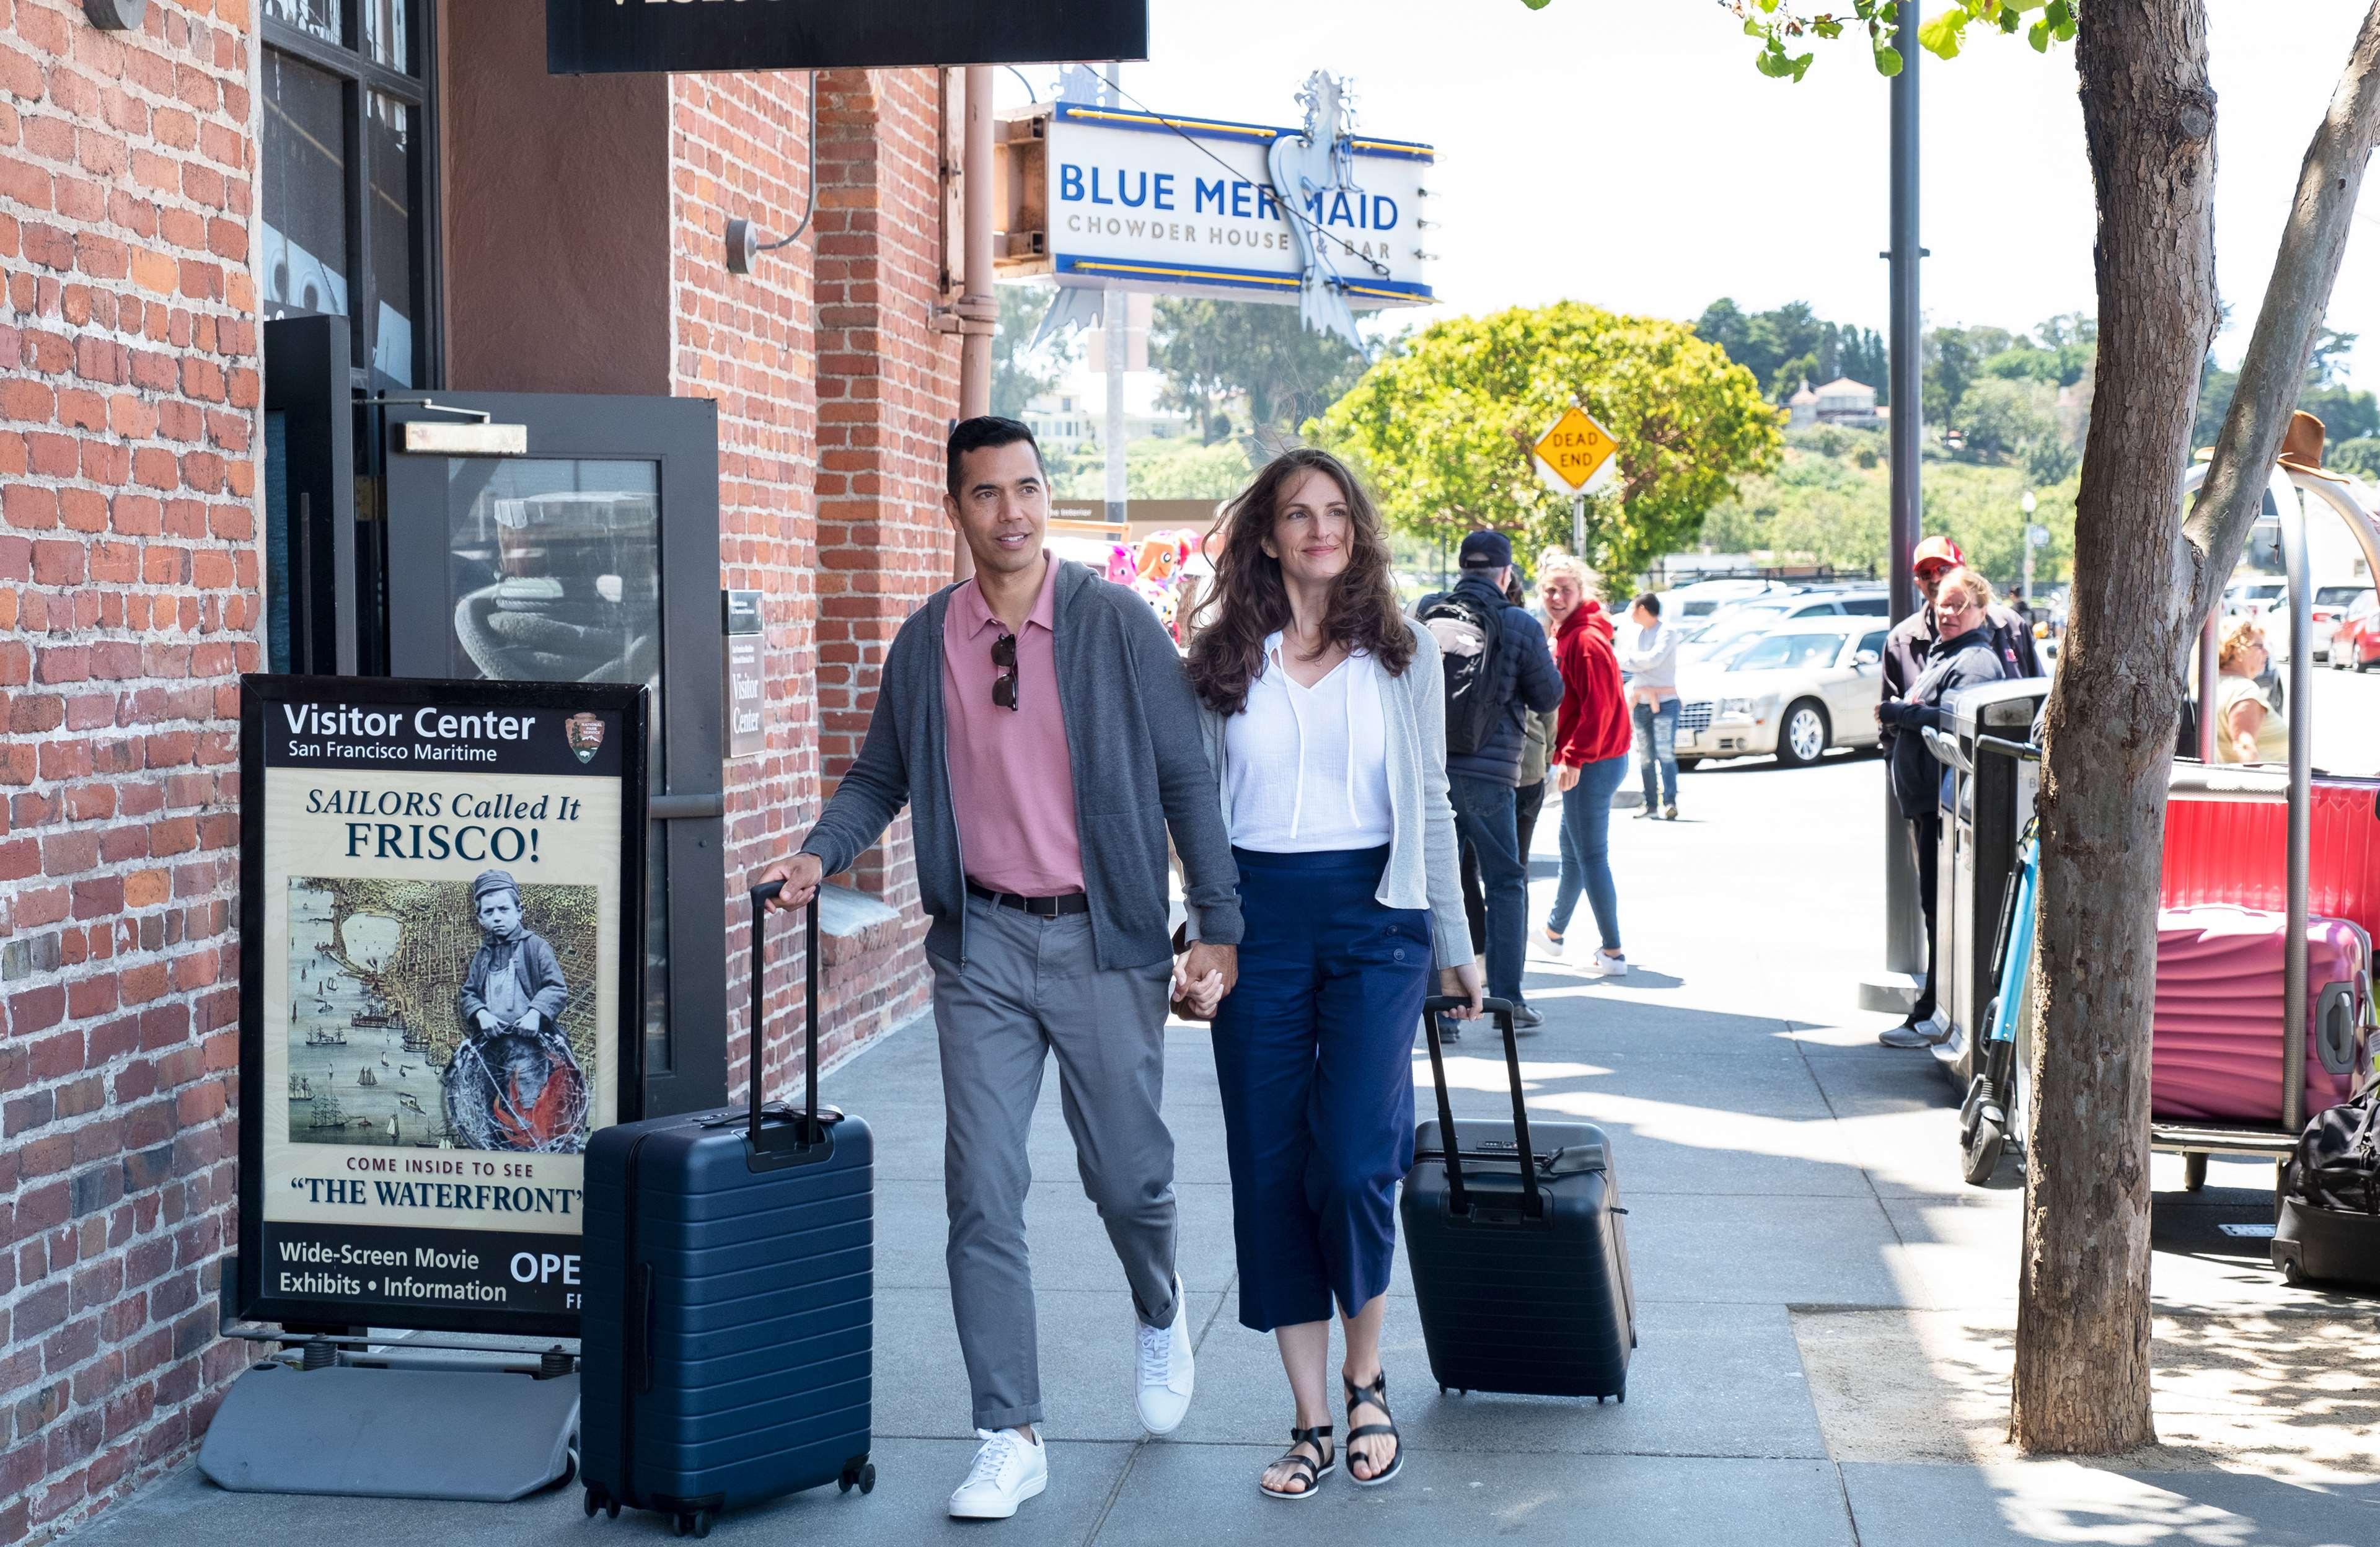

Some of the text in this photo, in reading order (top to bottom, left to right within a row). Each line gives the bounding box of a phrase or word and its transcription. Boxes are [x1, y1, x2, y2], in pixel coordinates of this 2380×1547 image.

[1060, 163, 1175, 211] BLUE
[1066, 214, 1196, 242] CHOWDER
[1209, 227, 1289, 250] HOUSE
[1344, 239, 1390, 259] BAR
[1553, 432, 1598, 447] DEAD
[1560, 452, 1593, 468] END
[1060, 508, 1092, 517] Interior
[733, 672, 759, 700] Visitor
[283, 702, 536, 741] Visitor Center
[733, 707, 760, 734] Center
[288, 739, 498, 762] San Francisco Maritime
[305, 788, 582, 821] SAILORS Called It
[344, 822, 539, 863] FRISCO!
[346, 1157, 534, 1178] COME INSIDE TO SEE
[278, 1241, 480, 1270] Wide-Screen Movie
[509, 1251, 581, 1285] OPE
[280, 1272, 507, 1302] Exhibits Information
